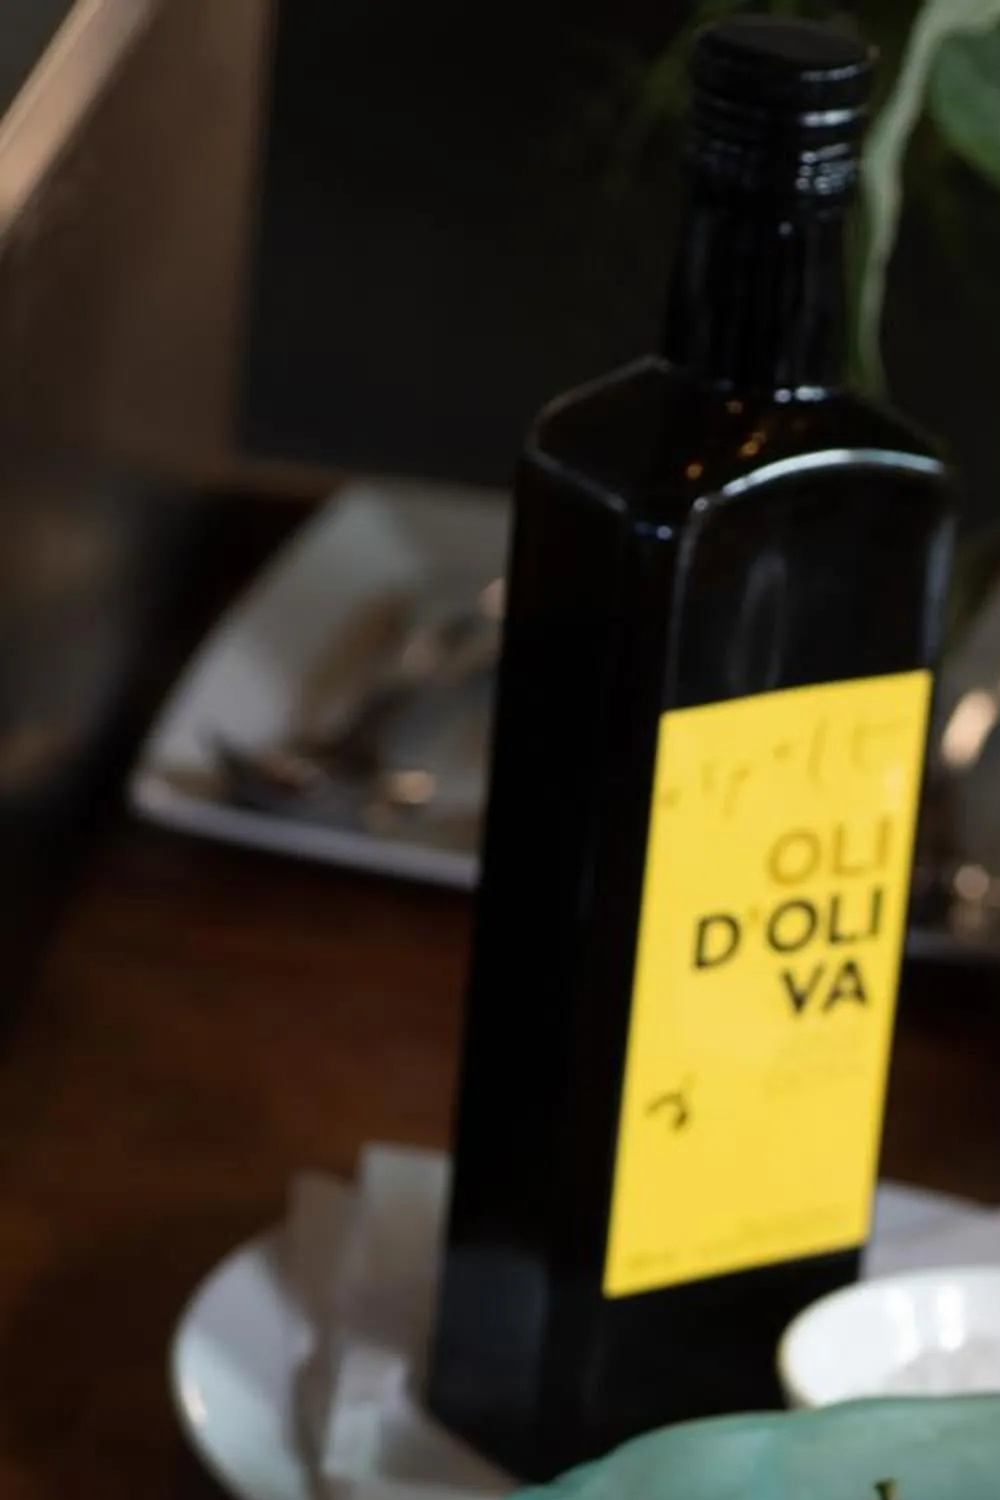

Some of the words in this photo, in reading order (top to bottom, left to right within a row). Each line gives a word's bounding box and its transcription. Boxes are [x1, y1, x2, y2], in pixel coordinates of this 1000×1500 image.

[767, 814, 892, 887] OLI
[692, 886, 883, 971] D'OLI
[780, 959, 868, 1016] VA
